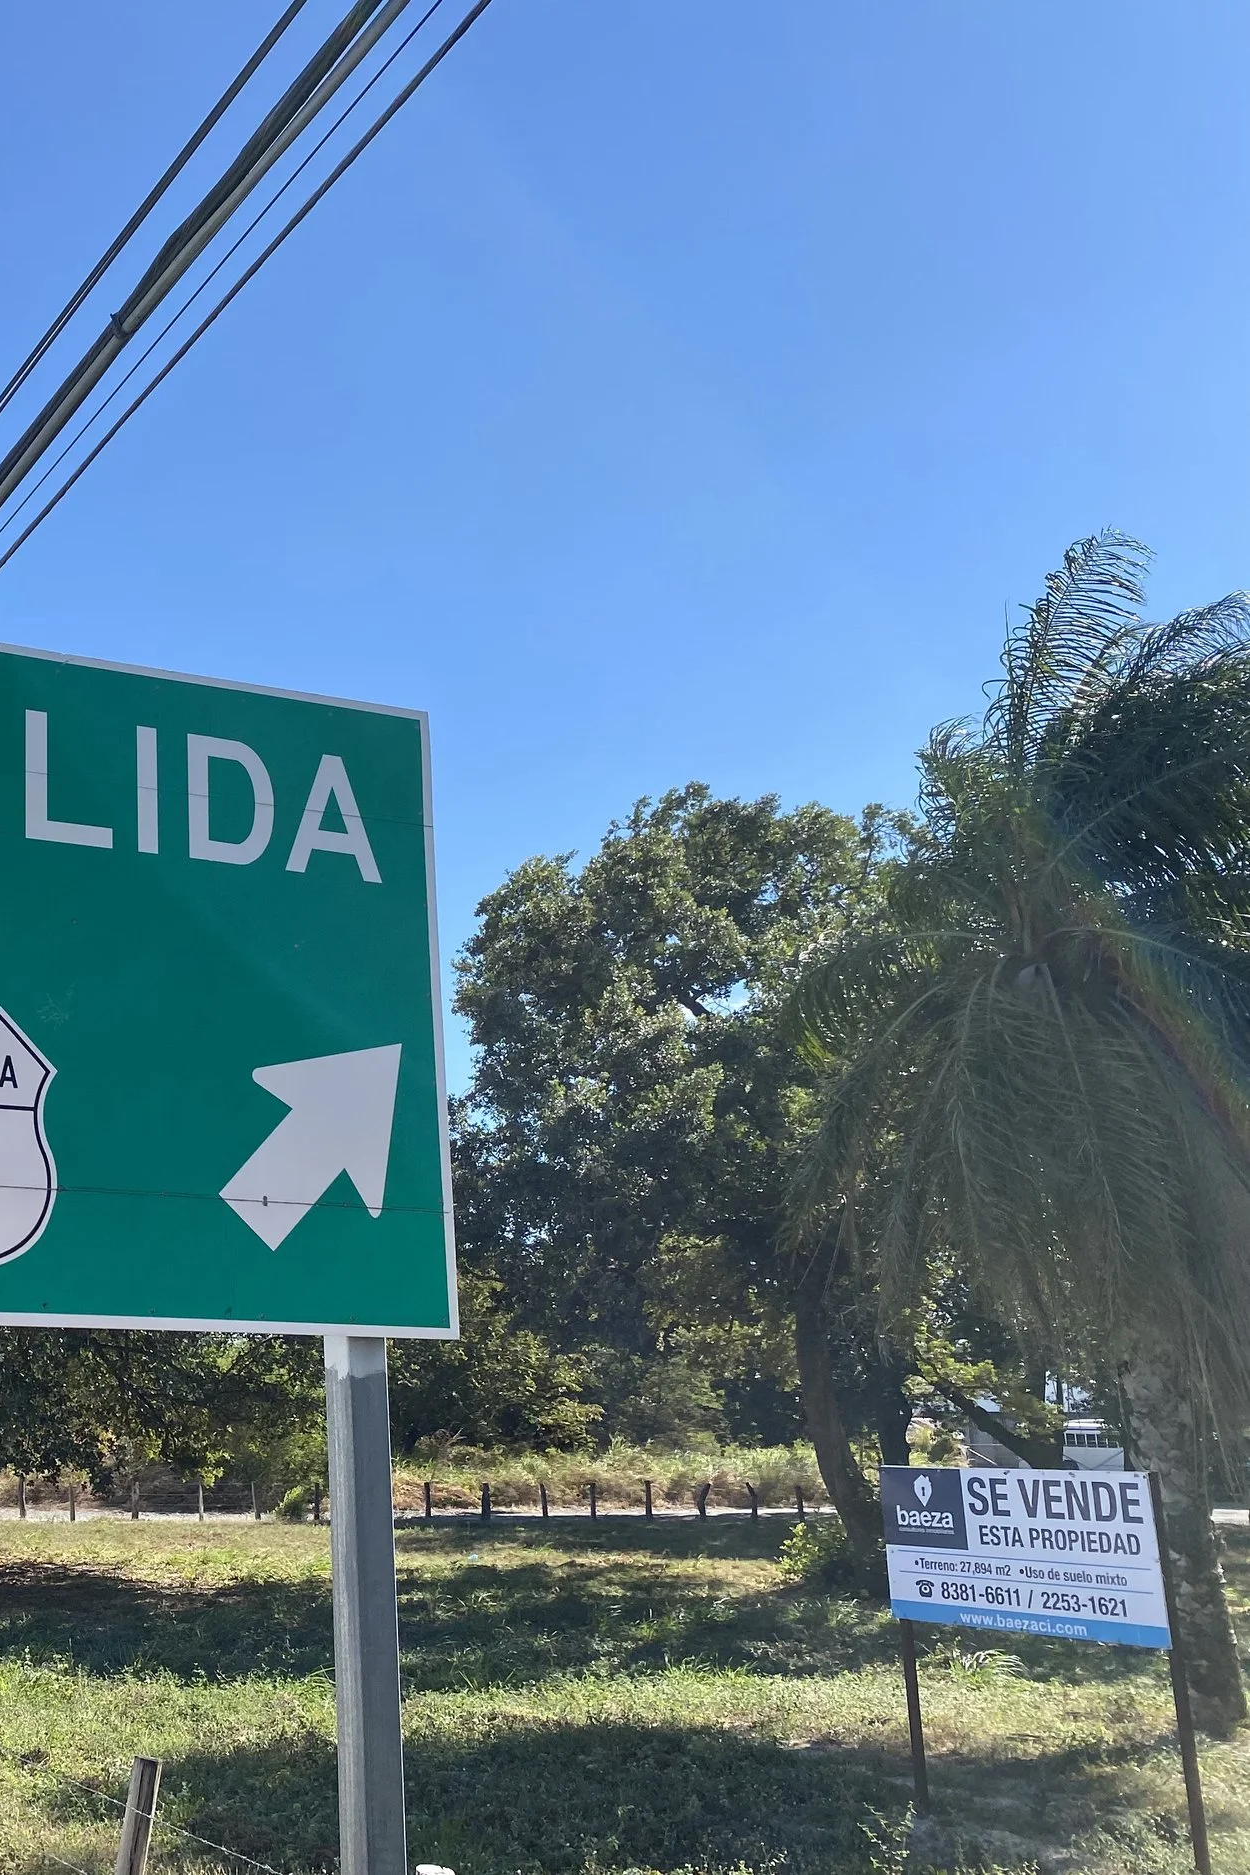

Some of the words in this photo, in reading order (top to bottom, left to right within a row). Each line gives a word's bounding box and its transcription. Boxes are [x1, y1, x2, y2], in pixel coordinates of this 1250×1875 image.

[967, 1476, 1011, 1517] SE
[1016, 1478, 1144, 1524] VENDE
[896, 1504, 954, 1528] baeza
[978, 1524, 1024, 1548] ESTA
[1028, 1527, 1141, 1556] PROPIEDAD
[960, 1561, 992, 1575] 27,894
[995, 1564, 1011, 1576] m2
[1047, 1568, 1060, 1581] de
[1063, 1570, 1093, 1584] suelo
[1095, 1572, 1128, 1586] mixto
[941, 1581, 1021, 1607] 8381-6611
[1028, 1589, 1034, 1609] /
[1040, 1591, 1128, 1618] 2253-1621
[959, 1612, 1088, 1637] www.baezaci.com
